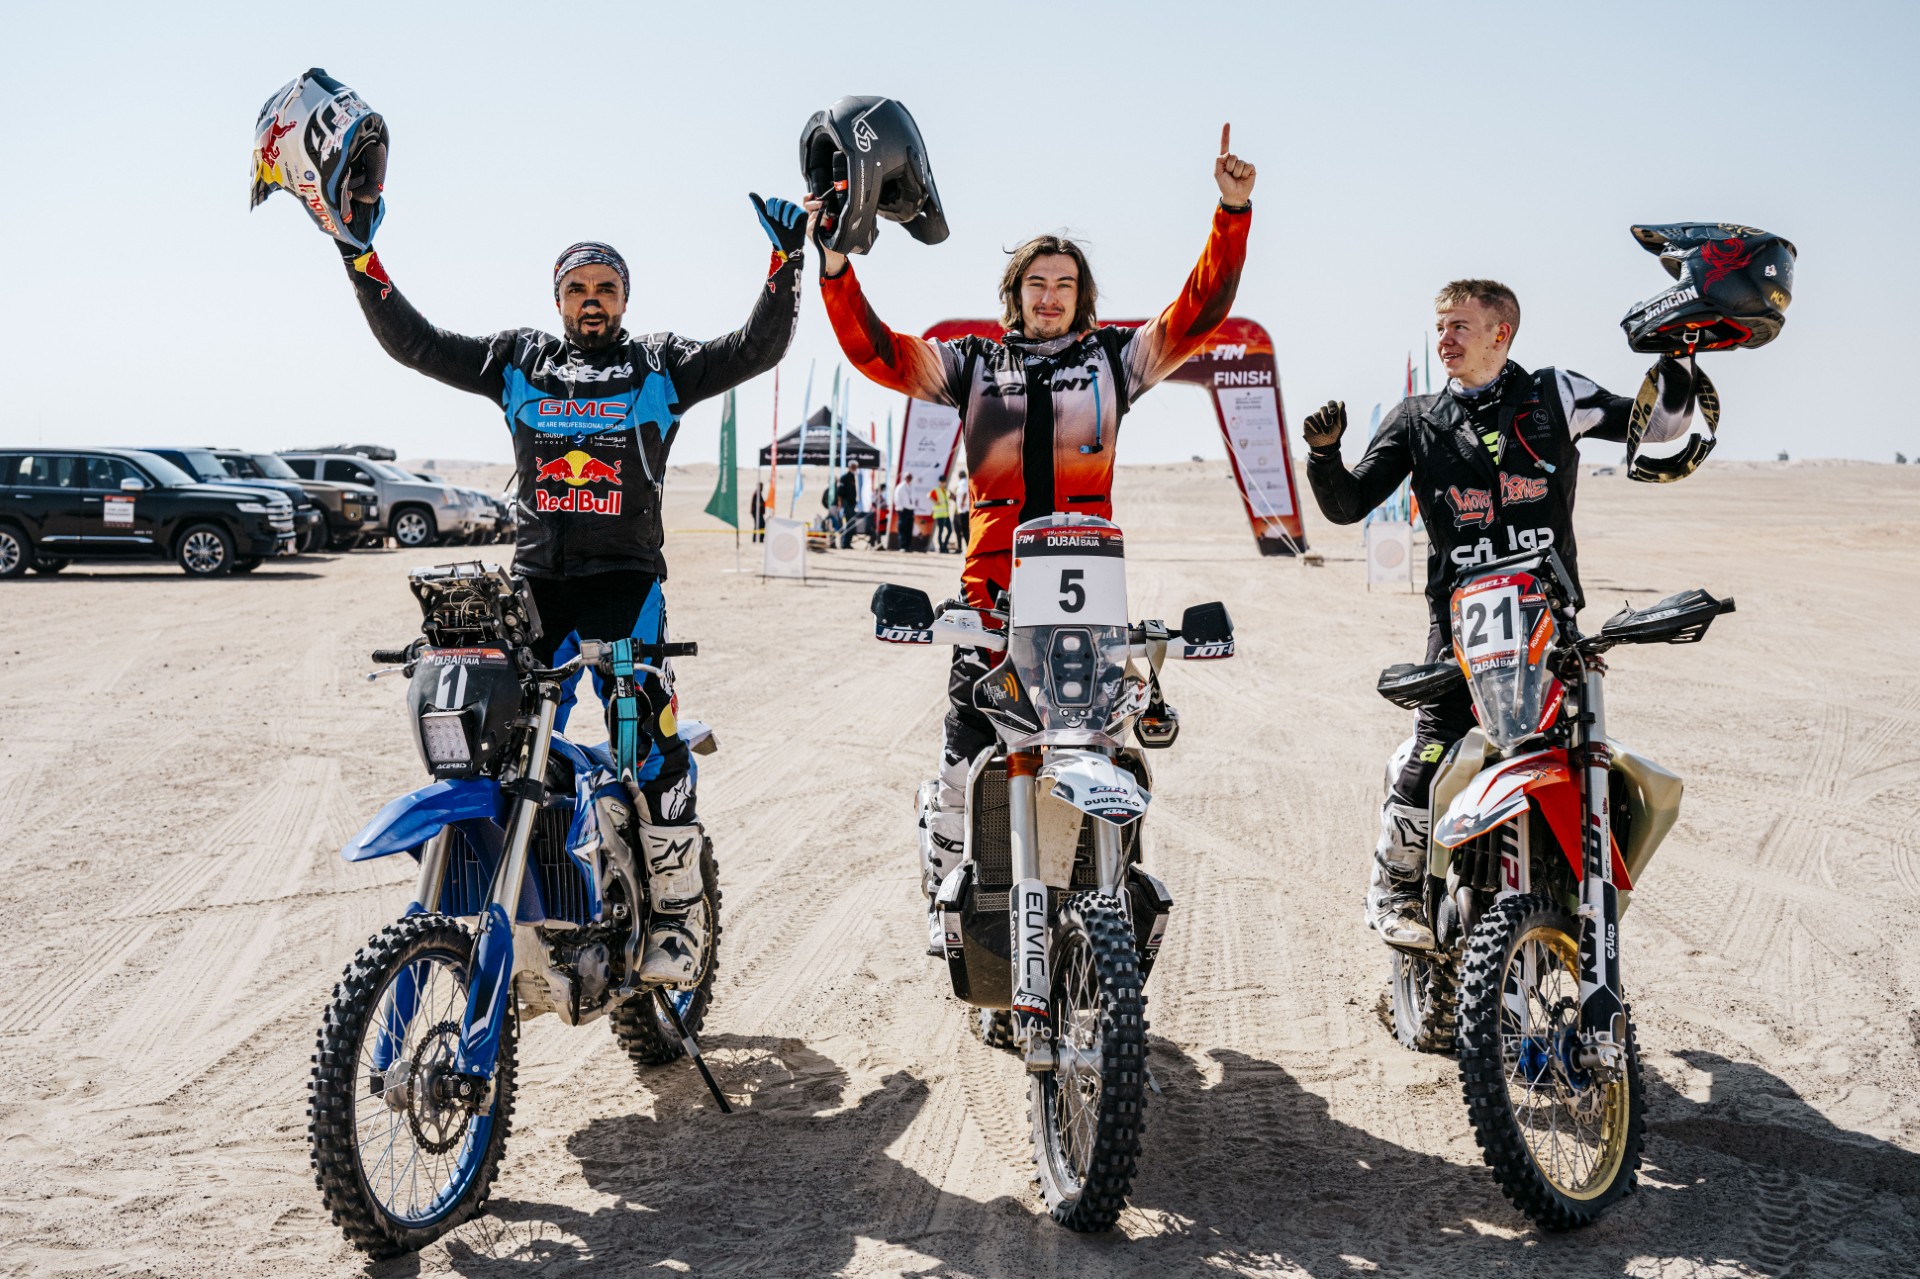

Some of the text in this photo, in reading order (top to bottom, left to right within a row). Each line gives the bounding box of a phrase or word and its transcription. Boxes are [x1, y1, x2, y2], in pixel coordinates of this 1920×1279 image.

[1210, 344, 1247, 361] FIM
[1214, 371, 1272, 386] FINISH
[538, 399, 627, 419] GMC
[558, 421, 604, 429] PROFESSIONAL
[605, 423, 627, 431] GRADE
[536, 488, 623, 515] Red Bull
[1047, 536, 1080, 547] DUBAI
[1080, 539, 1100, 547] BAJA
[1058, 569, 1086, 613] 5
[1466, 596, 1514, 649] 21
[434, 655, 480, 666] DUBAI BAJA
[1472, 658, 1500, 674] DUBAI
[438, 664, 467, 710] 1
[1084, 797, 1140, 807] DUUST.CO
[1014, 994, 1048, 1010] KTM
